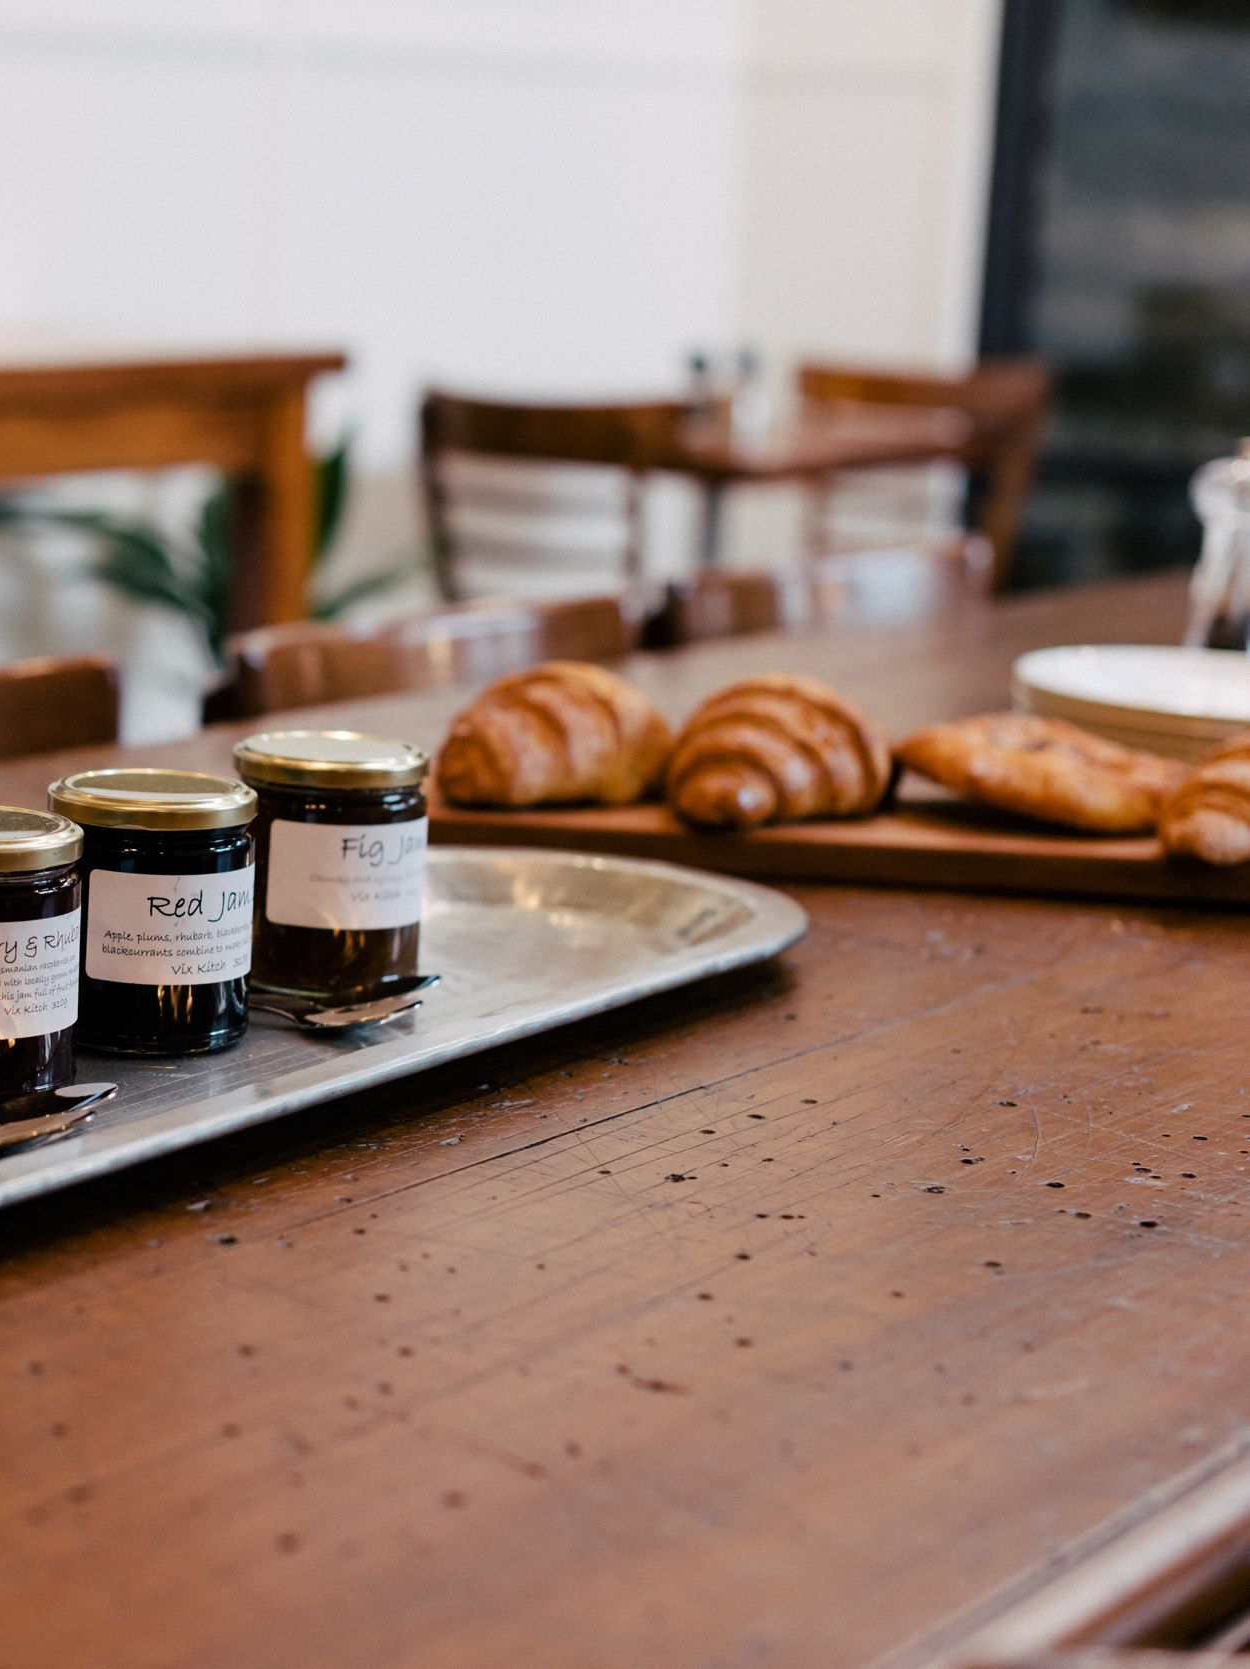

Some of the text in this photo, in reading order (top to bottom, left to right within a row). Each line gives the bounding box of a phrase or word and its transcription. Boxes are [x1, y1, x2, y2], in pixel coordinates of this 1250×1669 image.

[341, 833, 384, 867] Fig
[147, 889, 203, 918] Red
[103, 929, 134, 942] Apple,
[137, 931, 173, 944] plums,
[24, 936, 38, 957] &
[102, 944, 173, 957] blackcurrants
[176, 945, 214, 957] combine
[171, 962, 193, 976] Vix
[197, 960, 226, 974] Kitch
[3, 978, 22, 987] with
[24, 976, 50, 988] locally
[15, 990, 32, 1003] jam
[4, 1005, 21, 1016] Vix
[24, 1003, 48, 1014] Kitch
